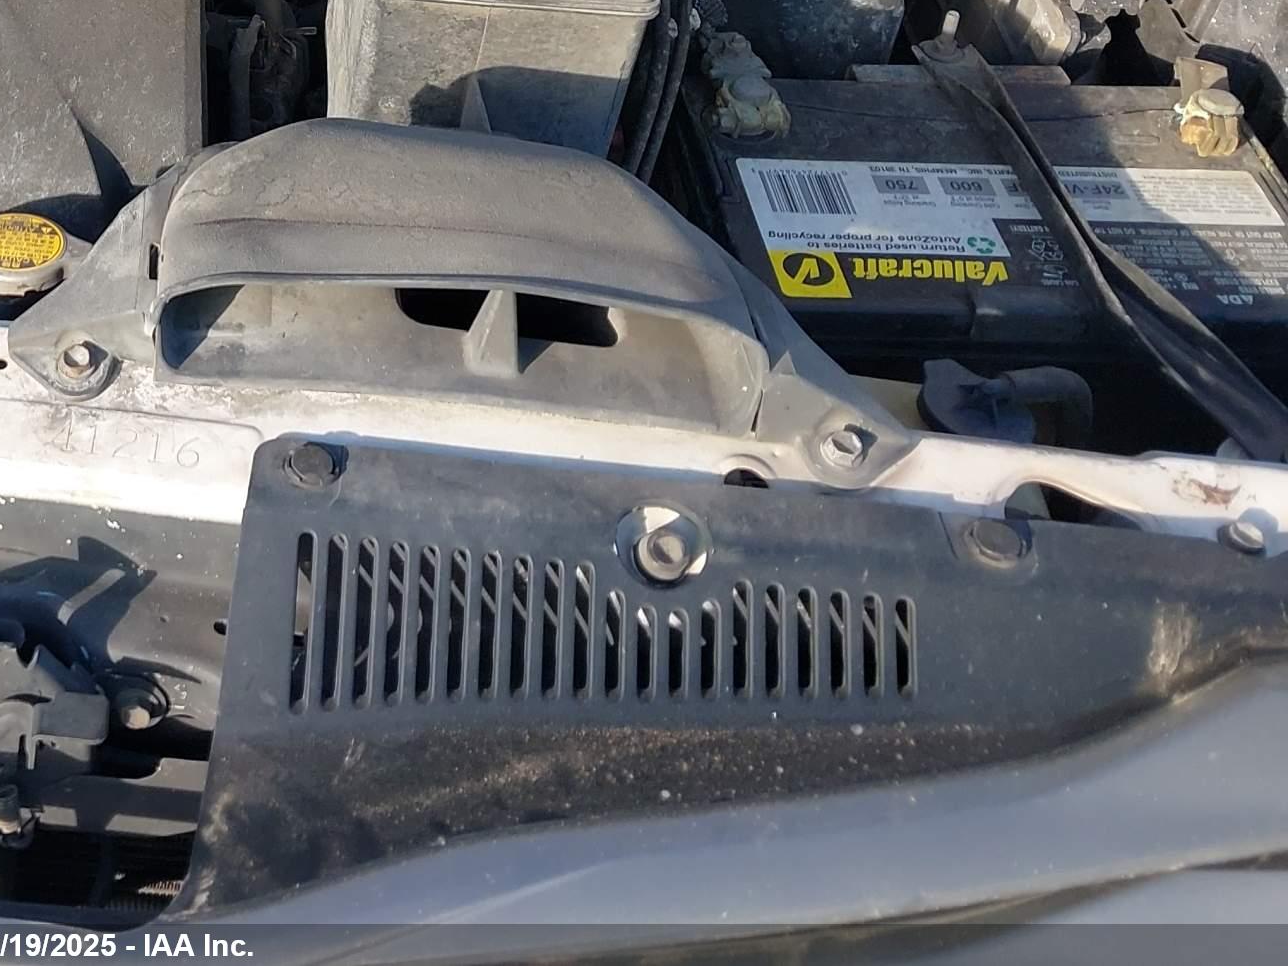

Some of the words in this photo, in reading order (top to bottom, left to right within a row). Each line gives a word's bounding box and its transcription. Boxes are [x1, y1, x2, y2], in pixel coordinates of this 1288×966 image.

[885, 179, 919, 191] 750
[950, 180, 983, 192] 600
[768, 230, 826, 241] recycling
[829, 232, 872, 242] proper
[876, 234, 893, 243] for
[897, 234, 962, 245] AutoZone
[807, 241, 820, 249] to
[823, 240, 881, 251] batteries
[885, 242, 917, 251] used
[921, 243, 966, 253] Return
[852, 257, 1009, 286] Valucraft
